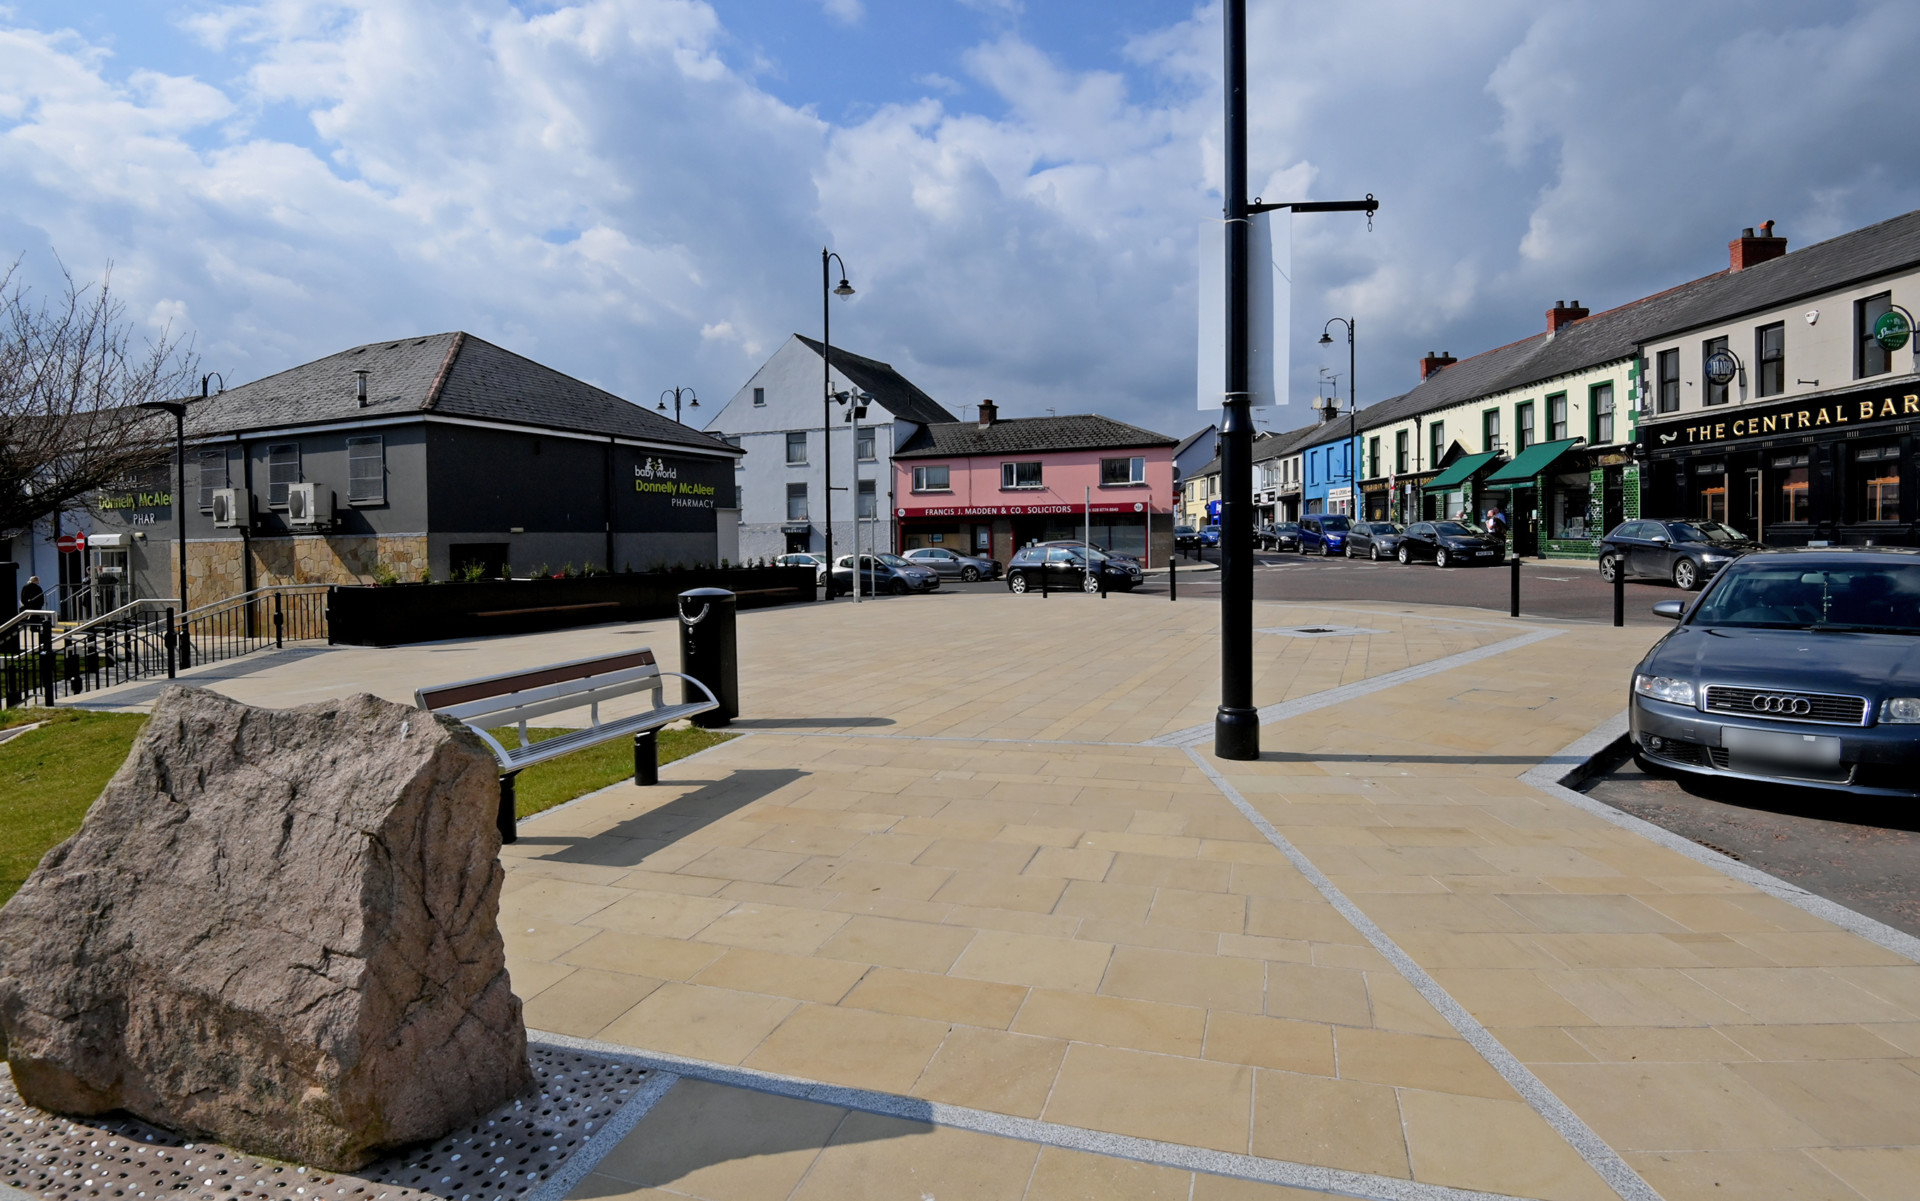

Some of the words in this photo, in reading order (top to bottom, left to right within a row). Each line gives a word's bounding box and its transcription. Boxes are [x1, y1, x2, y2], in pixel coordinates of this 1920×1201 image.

[1712, 361, 1733, 375] HARP
[1686, 422, 1726, 443] THE
[1732, 405, 1848, 437] CENTRAL
[1859, 394, 1920, 420] BAR
[634, 465, 655, 480] baby
[655, 467, 677, 479] world
[636, 480, 677, 496] Donnelly
[679, 482, 715, 495] McAleer
[671, 498, 714, 509] PHARMACY
[925, 508, 955, 516] FRANCIS
[964, 507, 998, 515] MADDEN
[1000, 506, 1007, 515] &
[1010, 506, 1024, 514] CO.
[1027, 505, 1072, 514] SOLICITORS
[133, 513, 155, 524] PHAR
